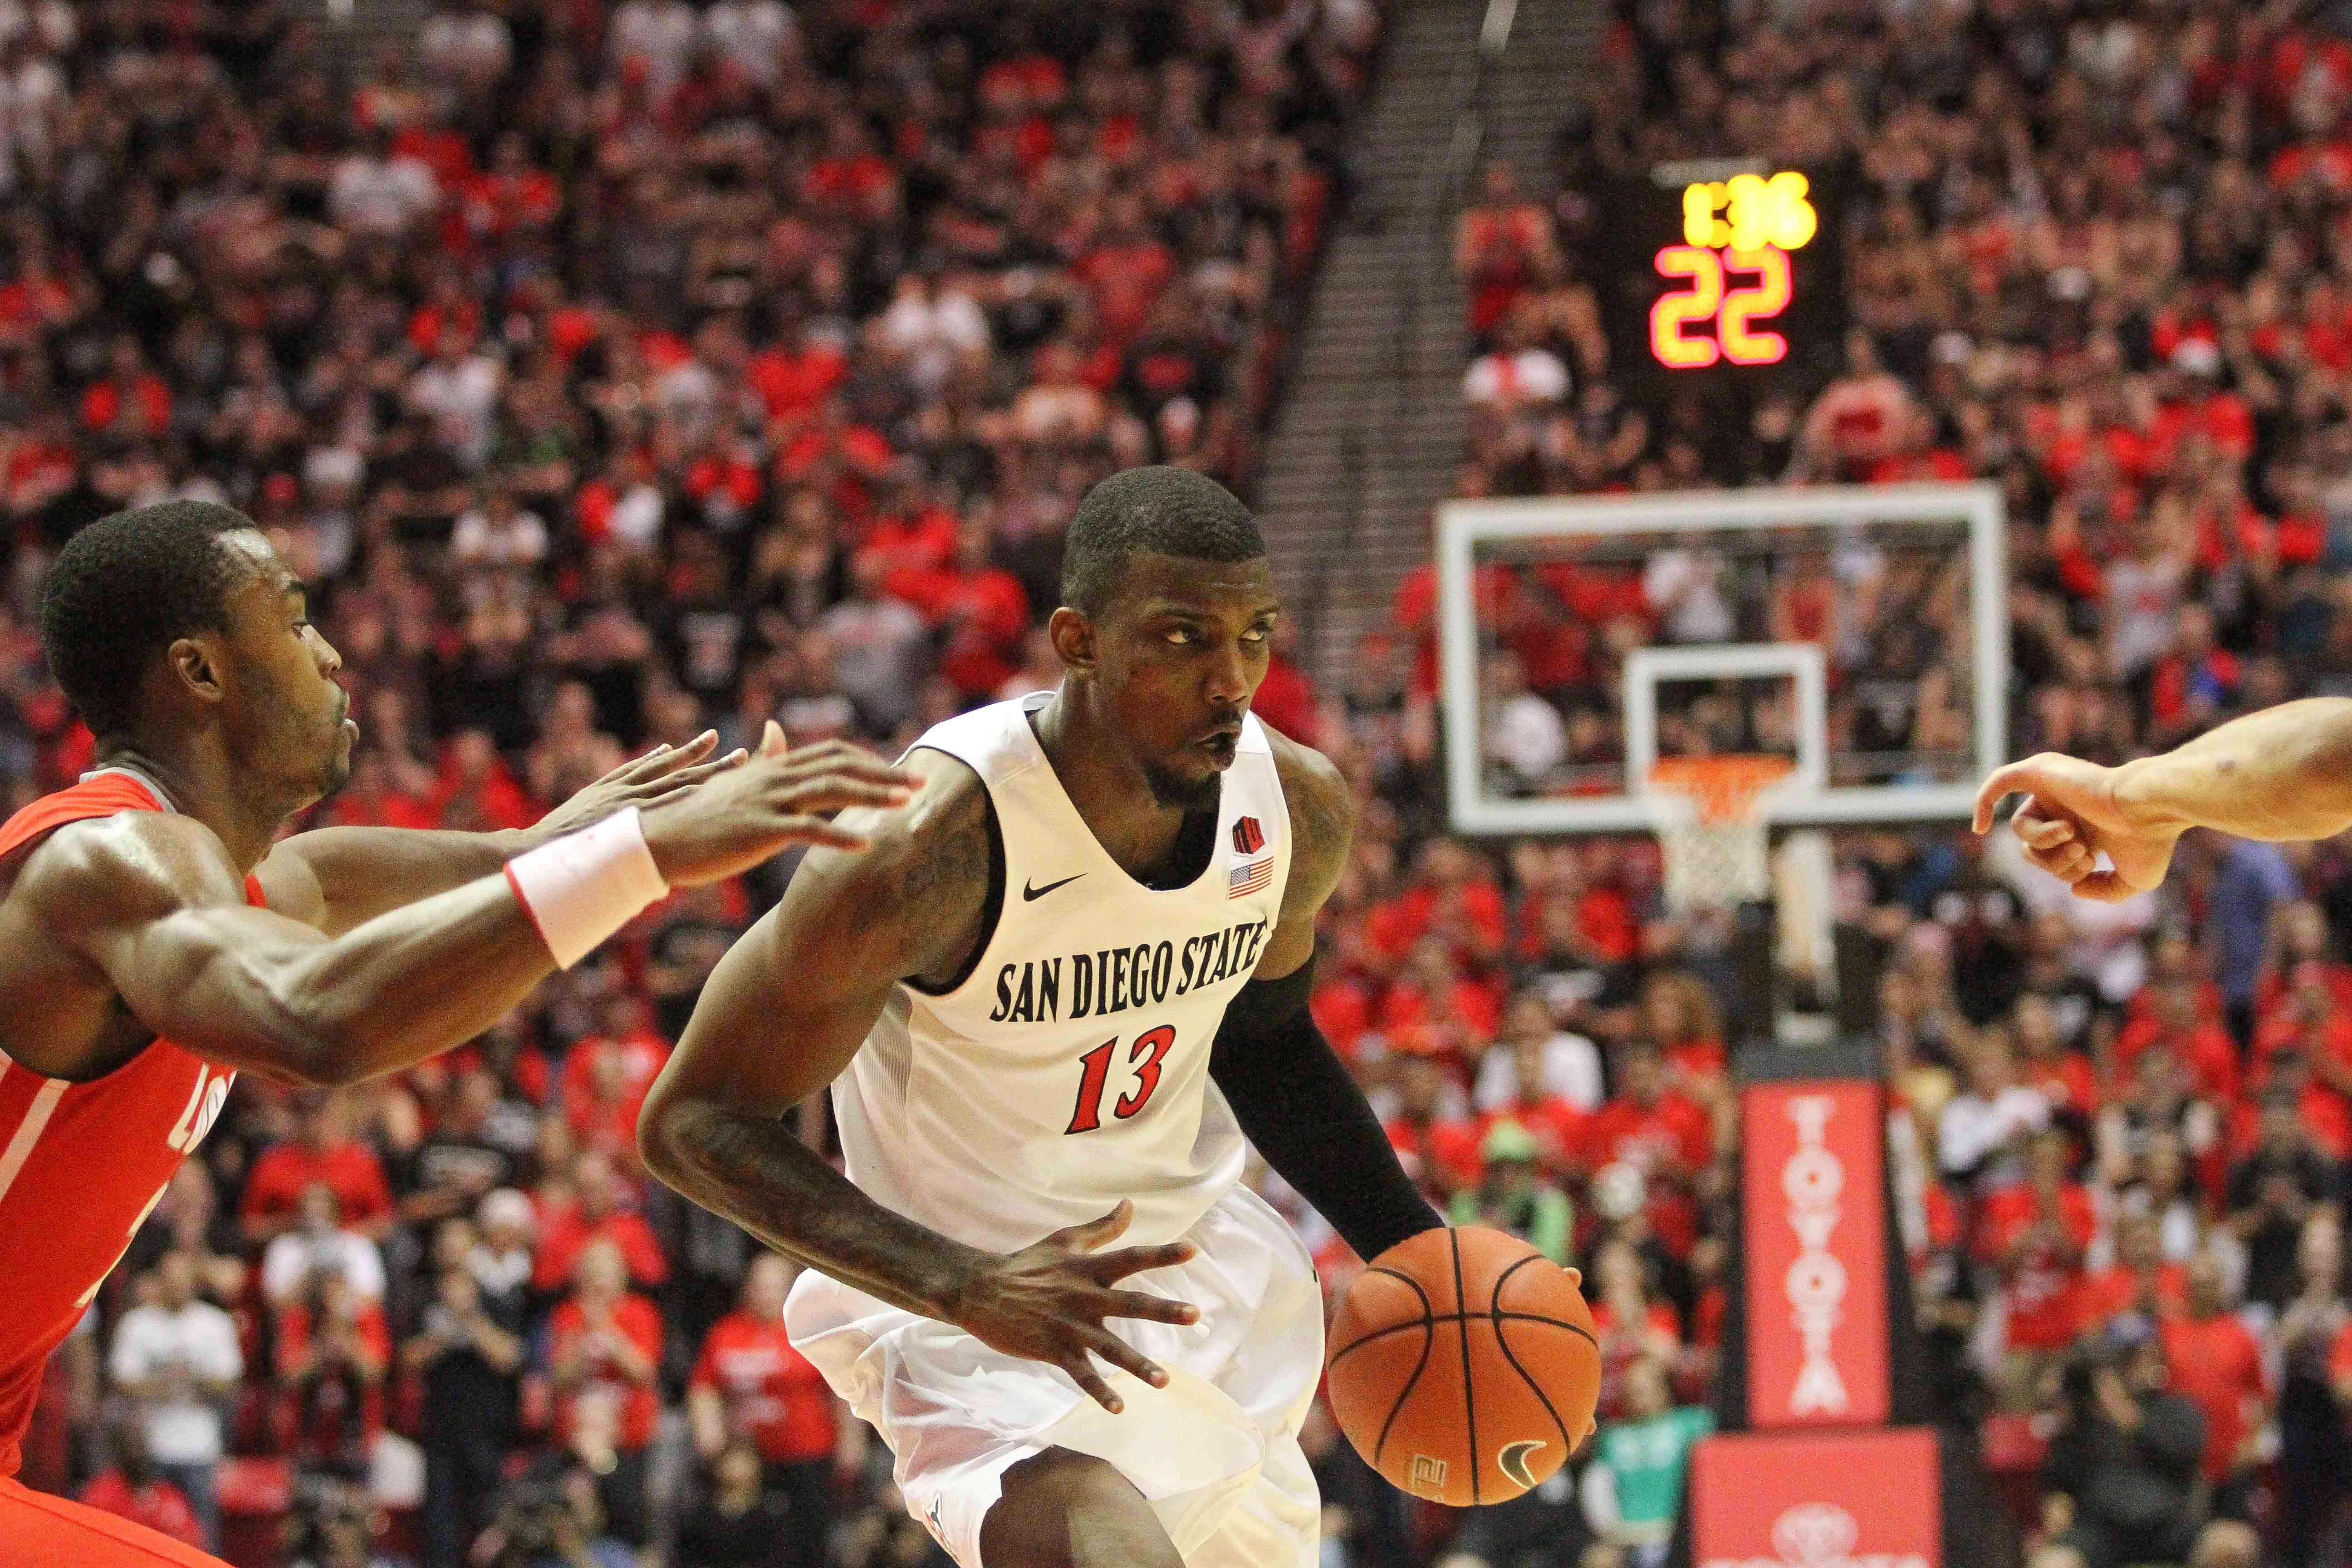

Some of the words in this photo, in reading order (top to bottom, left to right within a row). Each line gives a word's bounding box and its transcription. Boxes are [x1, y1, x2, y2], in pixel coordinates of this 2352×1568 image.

[1650, 245, 1793, 369] 22
[989, 957, 1062, 1024] SAN
[1069, 941, 1174, 1019] DIEGO
[1175, 919, 1267, 995] STATE
[1064, 1024, 1176, 1135] 13
[1779, 1094, 1849, 1417] TOYOTA
